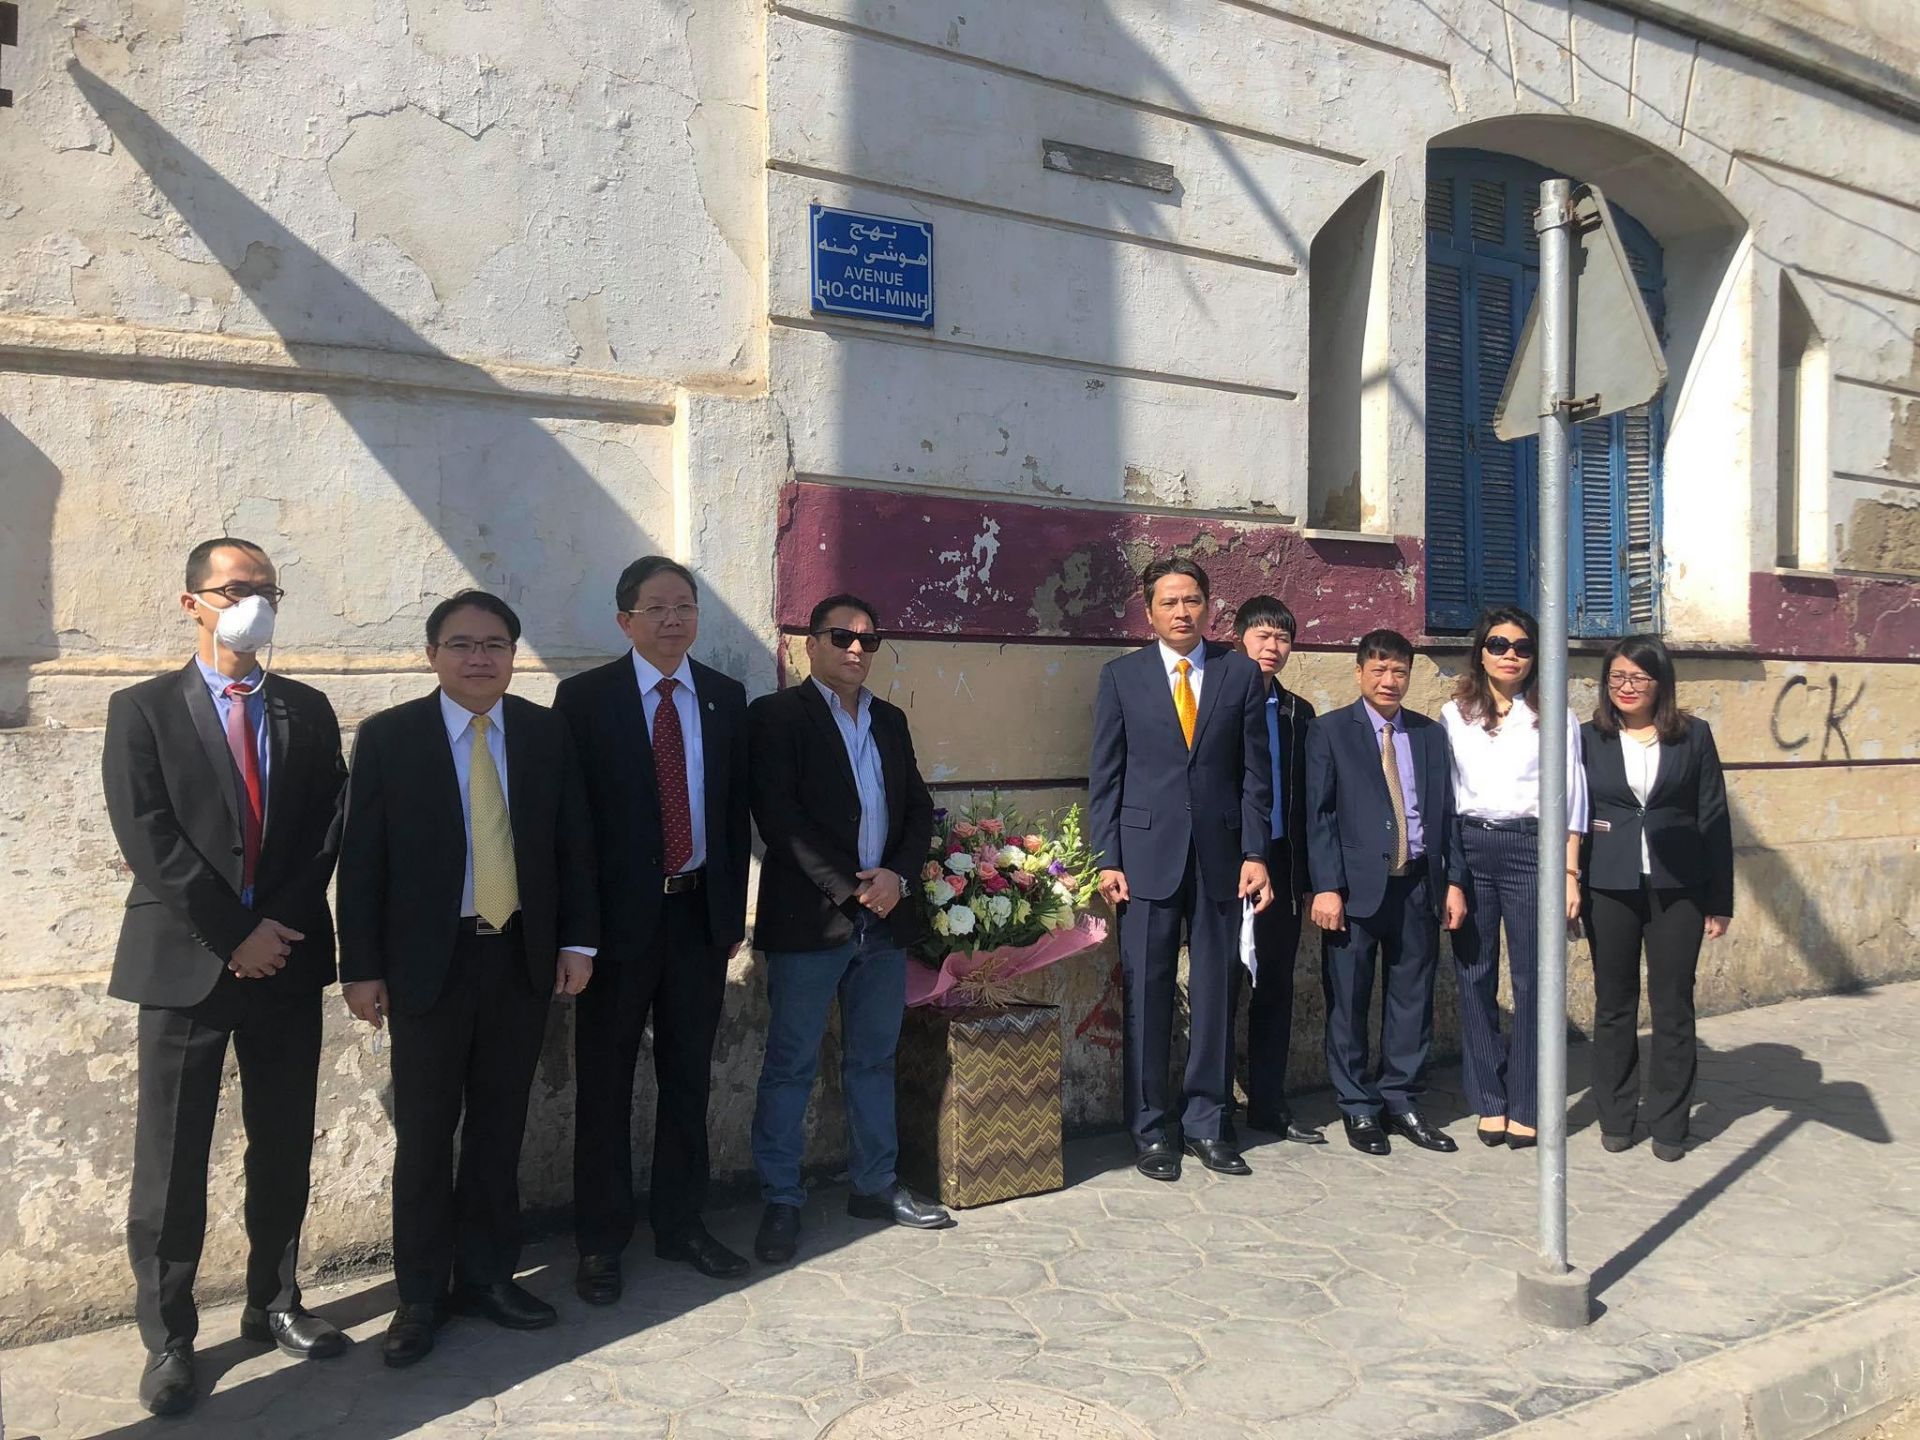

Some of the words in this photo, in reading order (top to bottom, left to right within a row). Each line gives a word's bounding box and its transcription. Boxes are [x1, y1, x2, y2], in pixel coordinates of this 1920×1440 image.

[849, 222, 898, 242] نهج
[843, 265, 904, 287] AVENUE
[818, 279, 928, 310] HO-CHI-MINH
